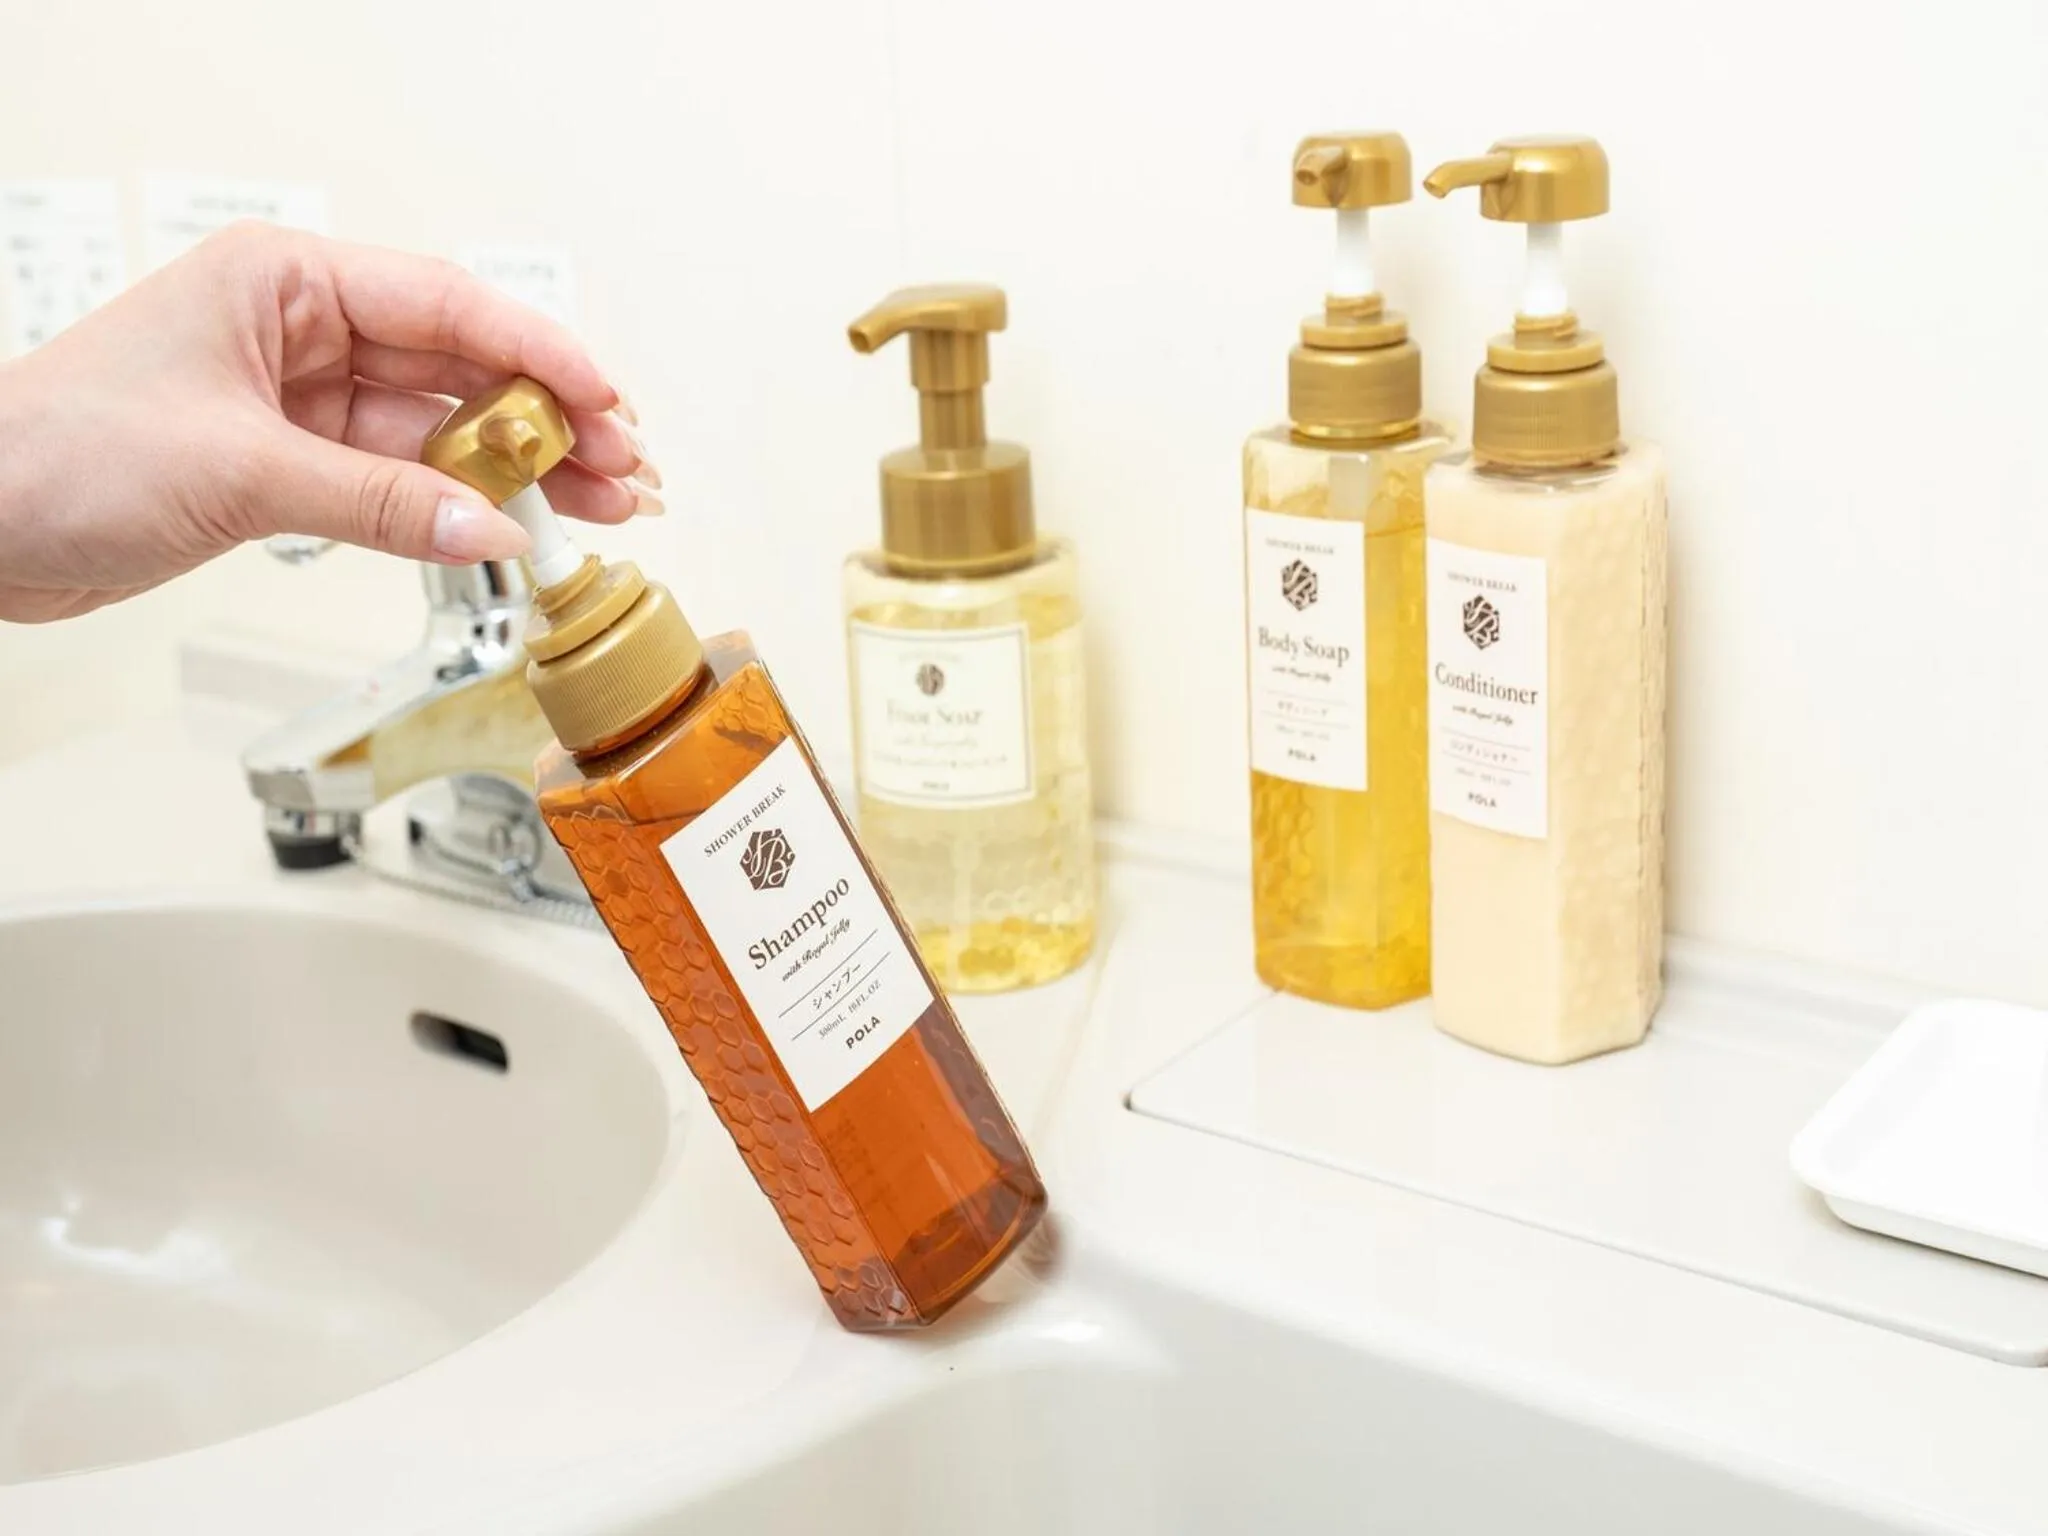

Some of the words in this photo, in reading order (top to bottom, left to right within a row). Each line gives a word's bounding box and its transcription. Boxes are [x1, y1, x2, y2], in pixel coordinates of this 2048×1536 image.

[1258, 626, 1298, 661] Body
[1303, 635, 1350, 668] Soap
[1435, 662, 1538, 705] Conditioner
[703, 814, 752, 858] SHOWER
[752, 784, 786, 818] BREAK
[748, 878, 849, 970] Shampoo
[782, 959, 802, 982] with
[802, 934, 829, 964] Royal
[829, 918, 850, 944] Jelly
[812, 964, 861, 1009] シャンプー
[846, 1016, 880, 1049] POLA
